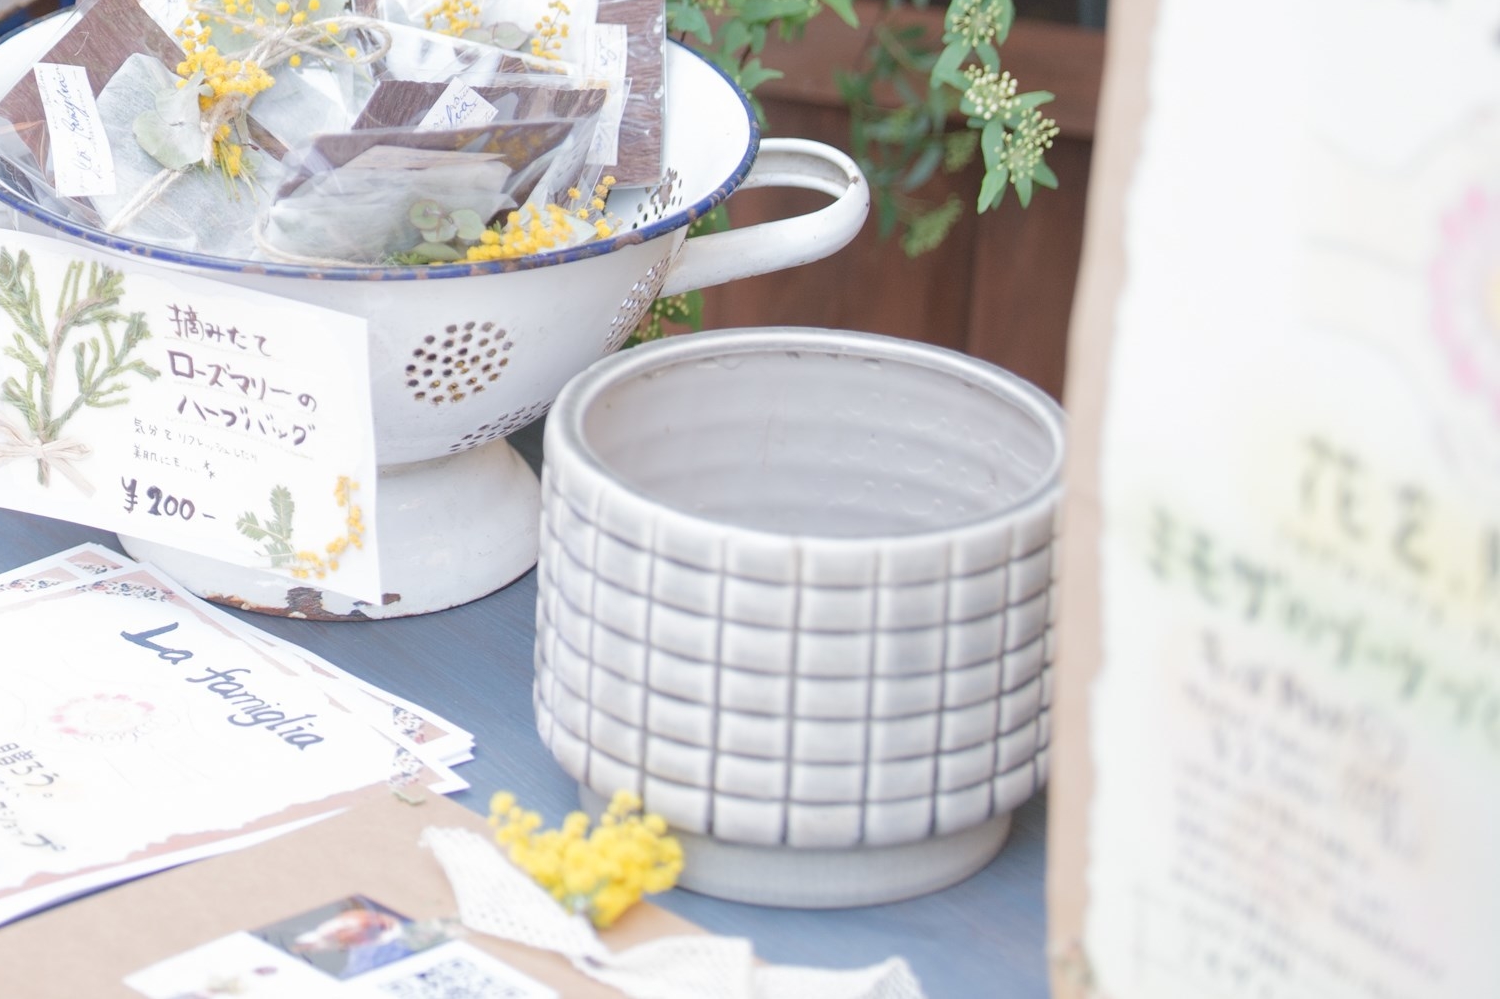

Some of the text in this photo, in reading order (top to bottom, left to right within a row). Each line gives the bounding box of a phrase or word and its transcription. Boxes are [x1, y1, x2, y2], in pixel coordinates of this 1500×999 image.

[167, 304, 271, 356] 摘みたて
[167, 349, 317, 413] ローズマリーの
[178, 395, 316, 447] ハーブバッグ
[120, 622, 325, 751] La famiglia
